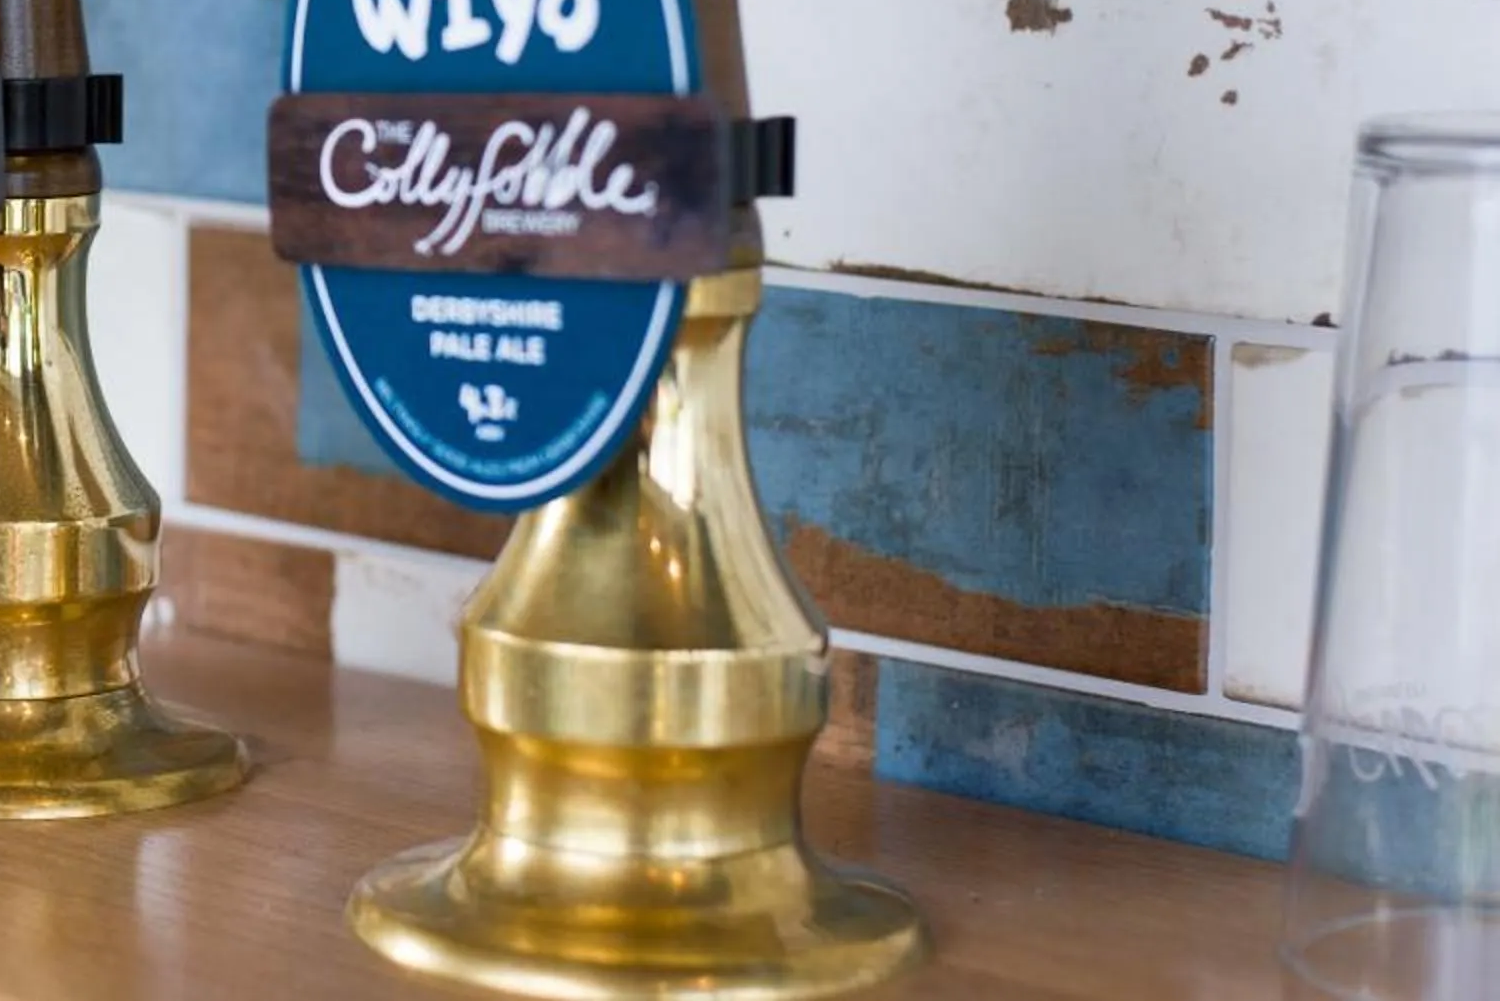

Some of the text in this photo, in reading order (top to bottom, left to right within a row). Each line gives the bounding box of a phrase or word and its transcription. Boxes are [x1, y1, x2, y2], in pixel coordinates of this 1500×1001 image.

[319, 106, 658, 256] Collyfobble
[429, 330, 546, 366] PALE ALE
